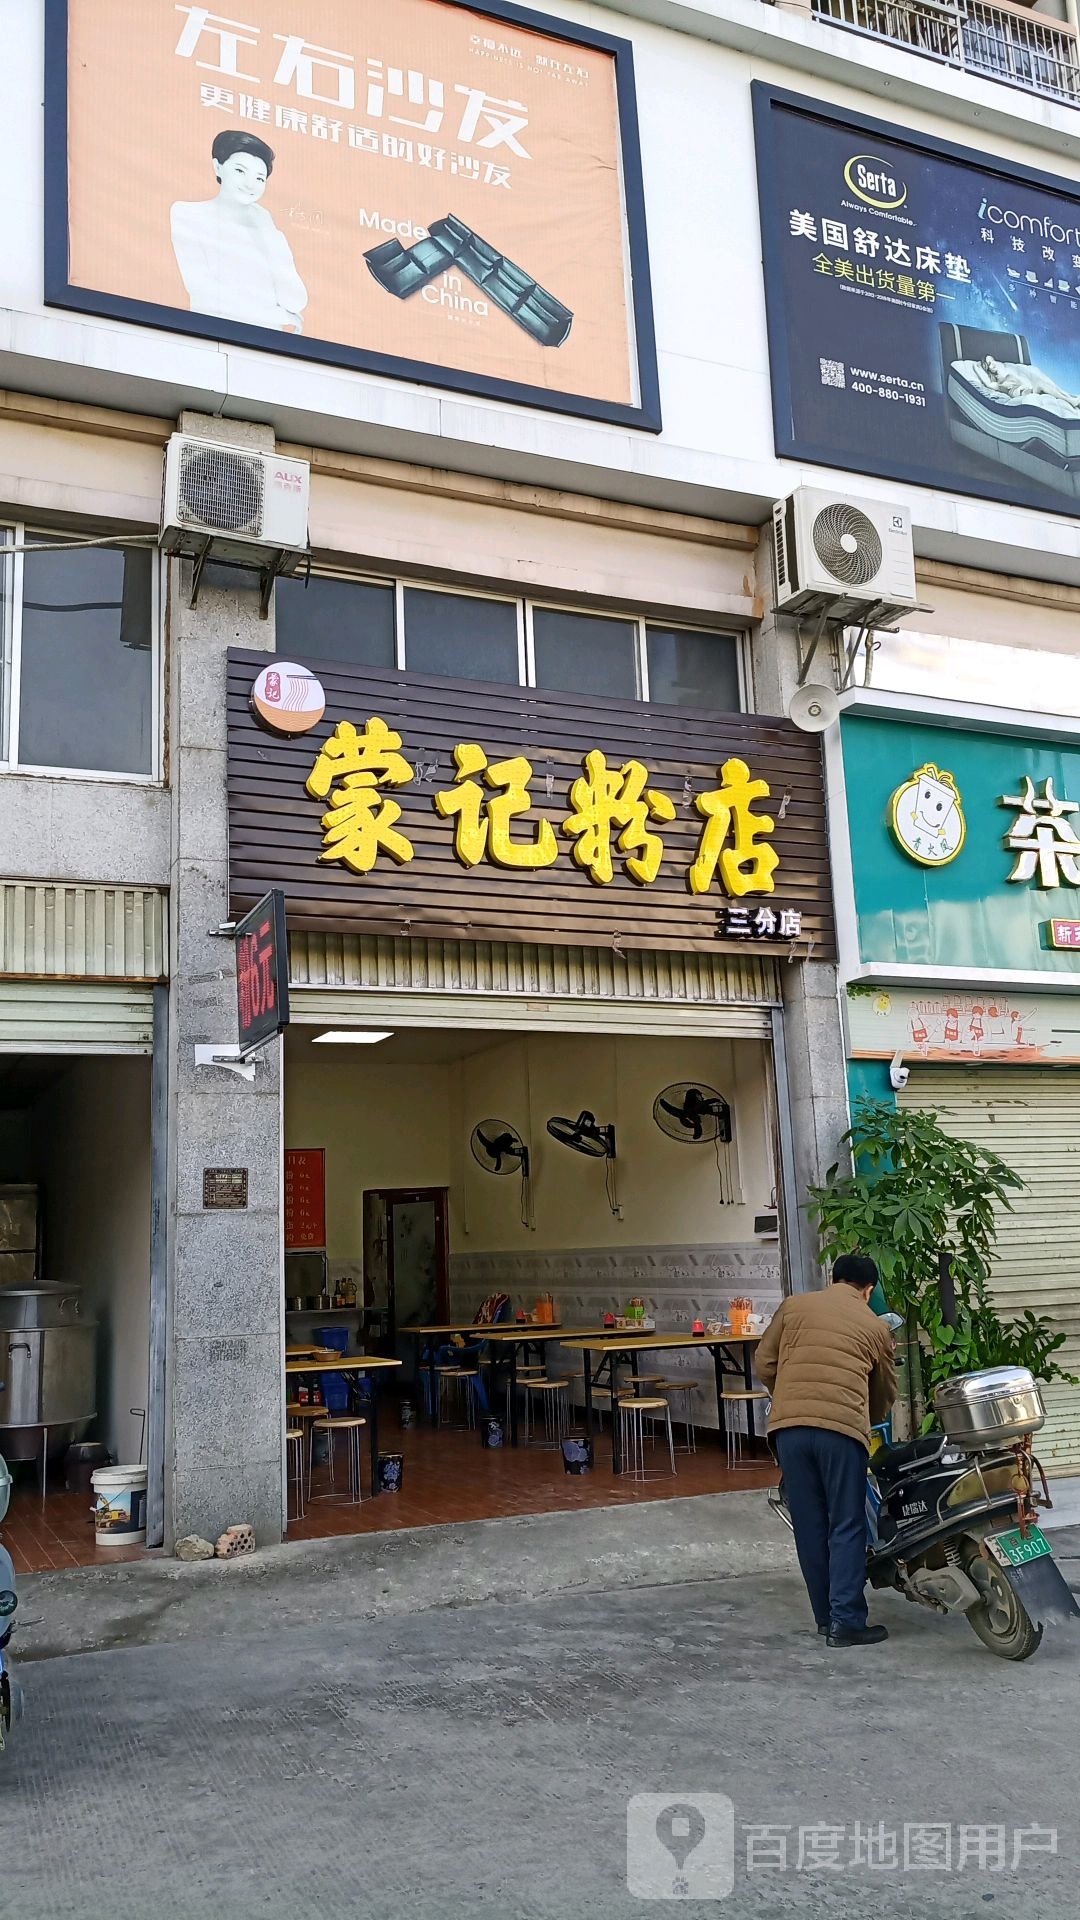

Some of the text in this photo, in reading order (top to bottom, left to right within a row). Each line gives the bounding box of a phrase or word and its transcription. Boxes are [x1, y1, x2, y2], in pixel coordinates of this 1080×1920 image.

[175, 4, 532, 159] 左右沙发
[857, 164, 897, 198] Serta
[841, 200, 867, 213] Always
[359, 208, 432, 241] Made
[789, 208, 972, 284] 美国舒达床垫
[443, 270, 462, 292] in
[812, 253, 955, 303] 全美出货量第一
[421, 284, 488, 316] China
[850, 367, 925, 391] www.serta.cn
[851, 382, 926, 407] 400-880-1931
[274, 471, 302, 484] AUX
[306, 716, 778, 898] 蒙记粉店
[1002, 776, 1080, 887] 茶
[727, 907, 802, 937] 三分店
[1009, 1538, 1047, 1562] 3F907
